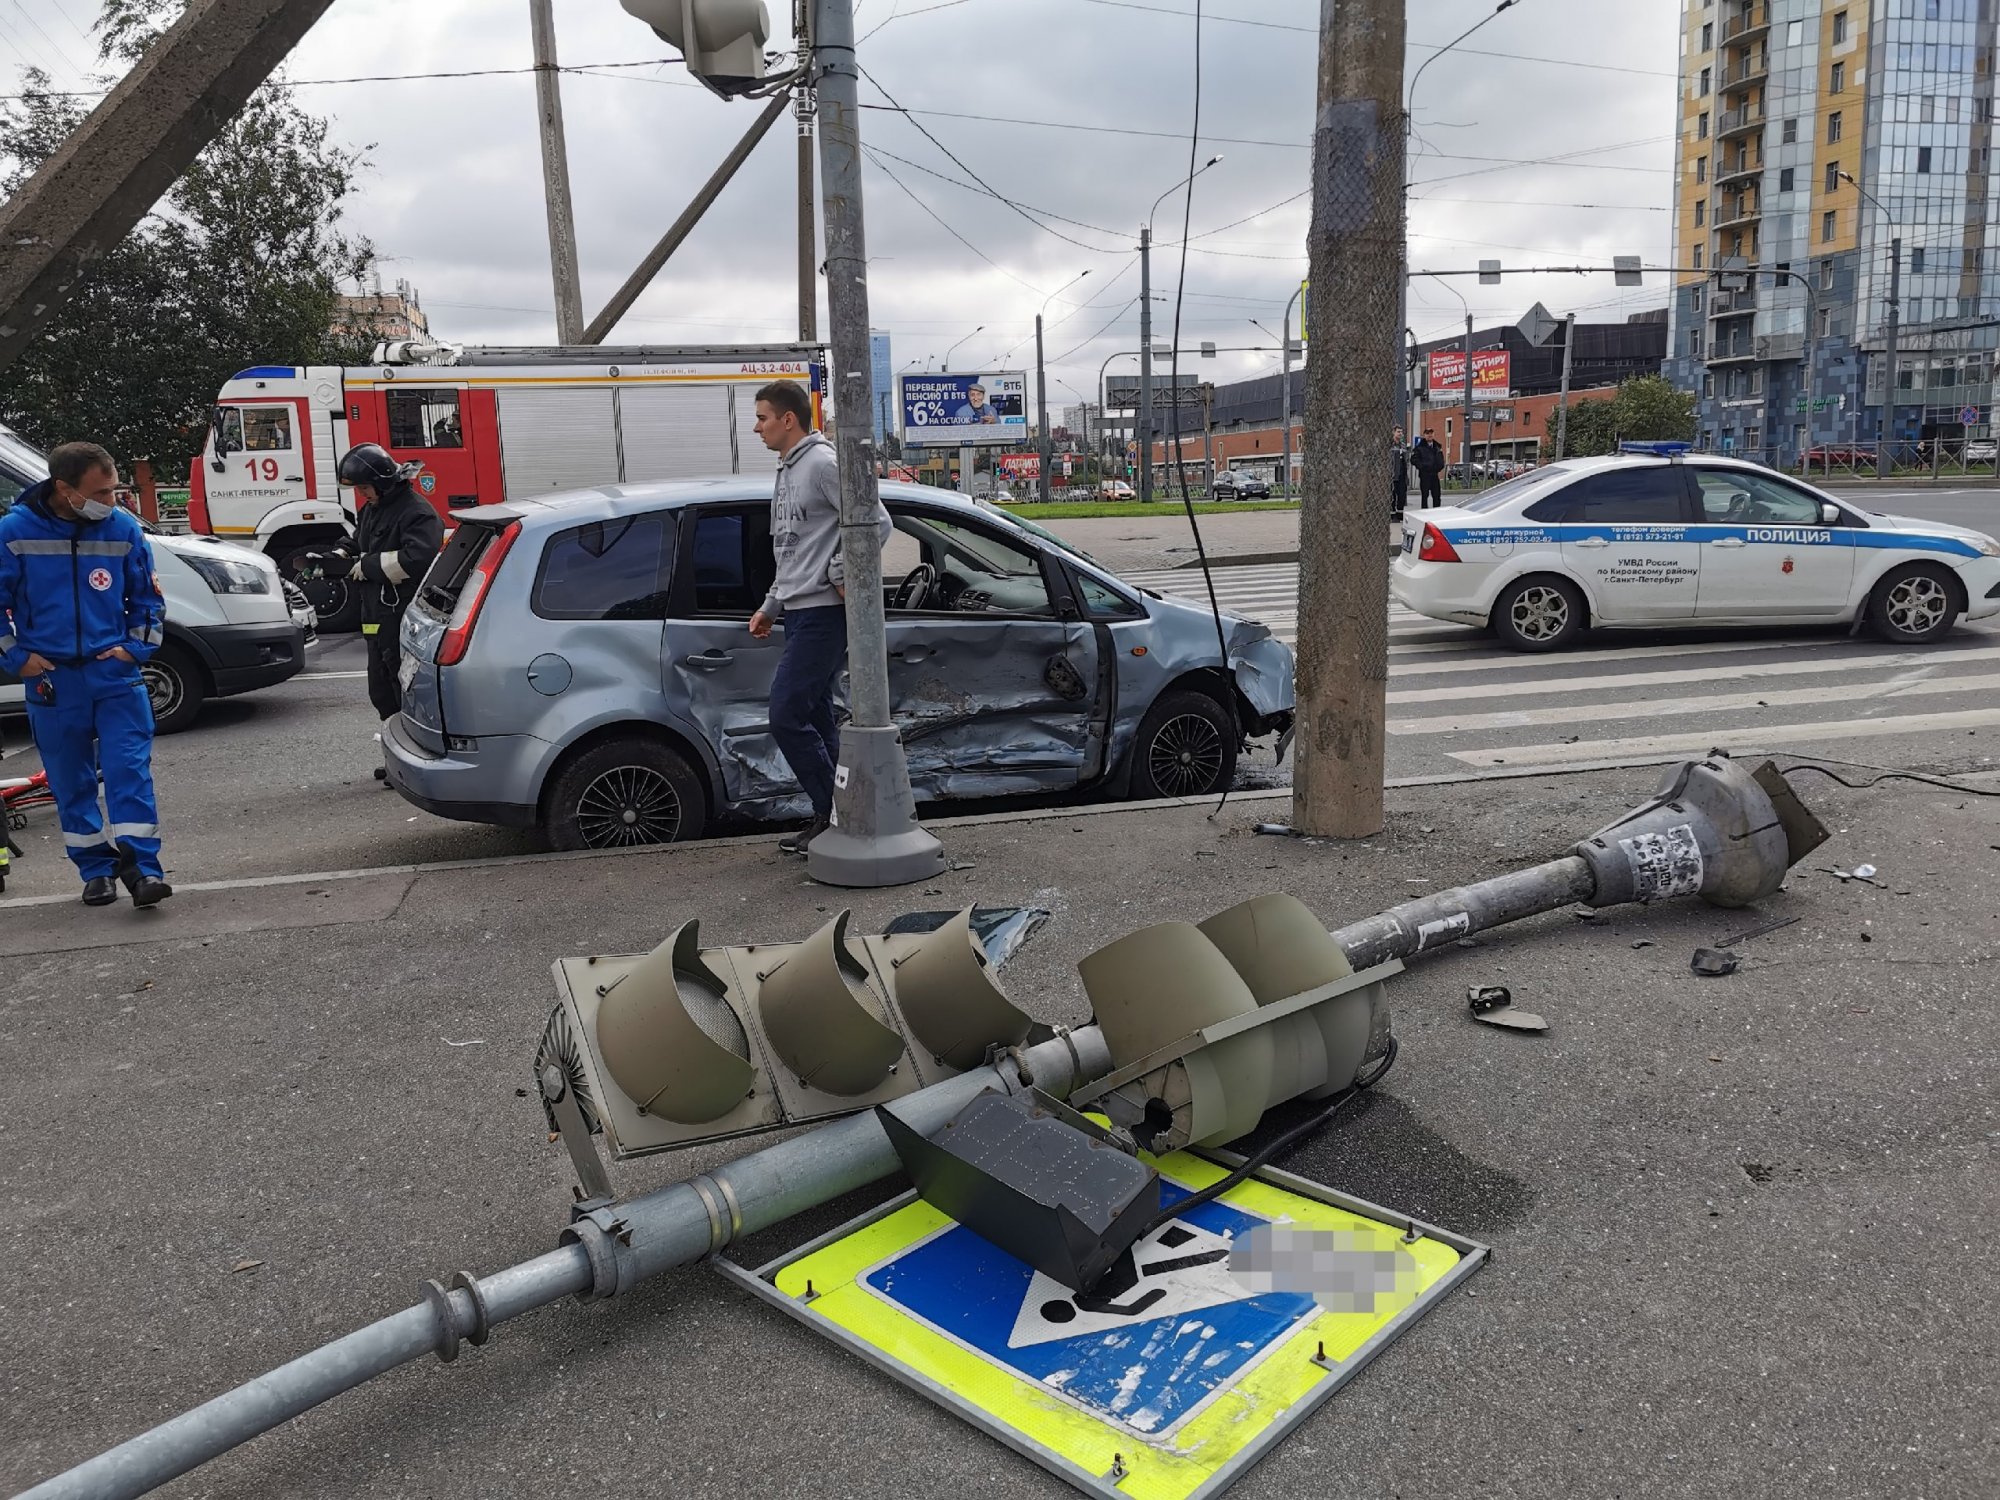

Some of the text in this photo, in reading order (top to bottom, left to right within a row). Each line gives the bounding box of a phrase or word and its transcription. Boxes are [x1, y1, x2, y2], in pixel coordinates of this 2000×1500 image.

[741, 363, 801, 374] АЦ-3,2-40/4
[1433, 365, 1458, 378] КУПИ
[1459, 355, 1506, 373] КАРТИРУ
[905, 383, 957, 392] ПЕРЕВЕДИТЕ
[1003, 381, 1021, 390] ВТБ
[906, 391, 966, 401] ПЕНСИЮ В ВТБ
[940, 416, 971, 424] ОСТАТОК
[245, 458, 278, 481] 19
[210, 489, 291, 498] САНКТ-ПЕТЕРБУРГ
[1504, 529, 1544, 537] дежурной
[1747, 529, 1831, 544] ПОЛИЦИЯ
[1618, 559, 1643, 567] УМВД
[1611, 568, 1662, 576] Кировскому
[1604, 576, 1684, 584] г.Санкт-Петербург
